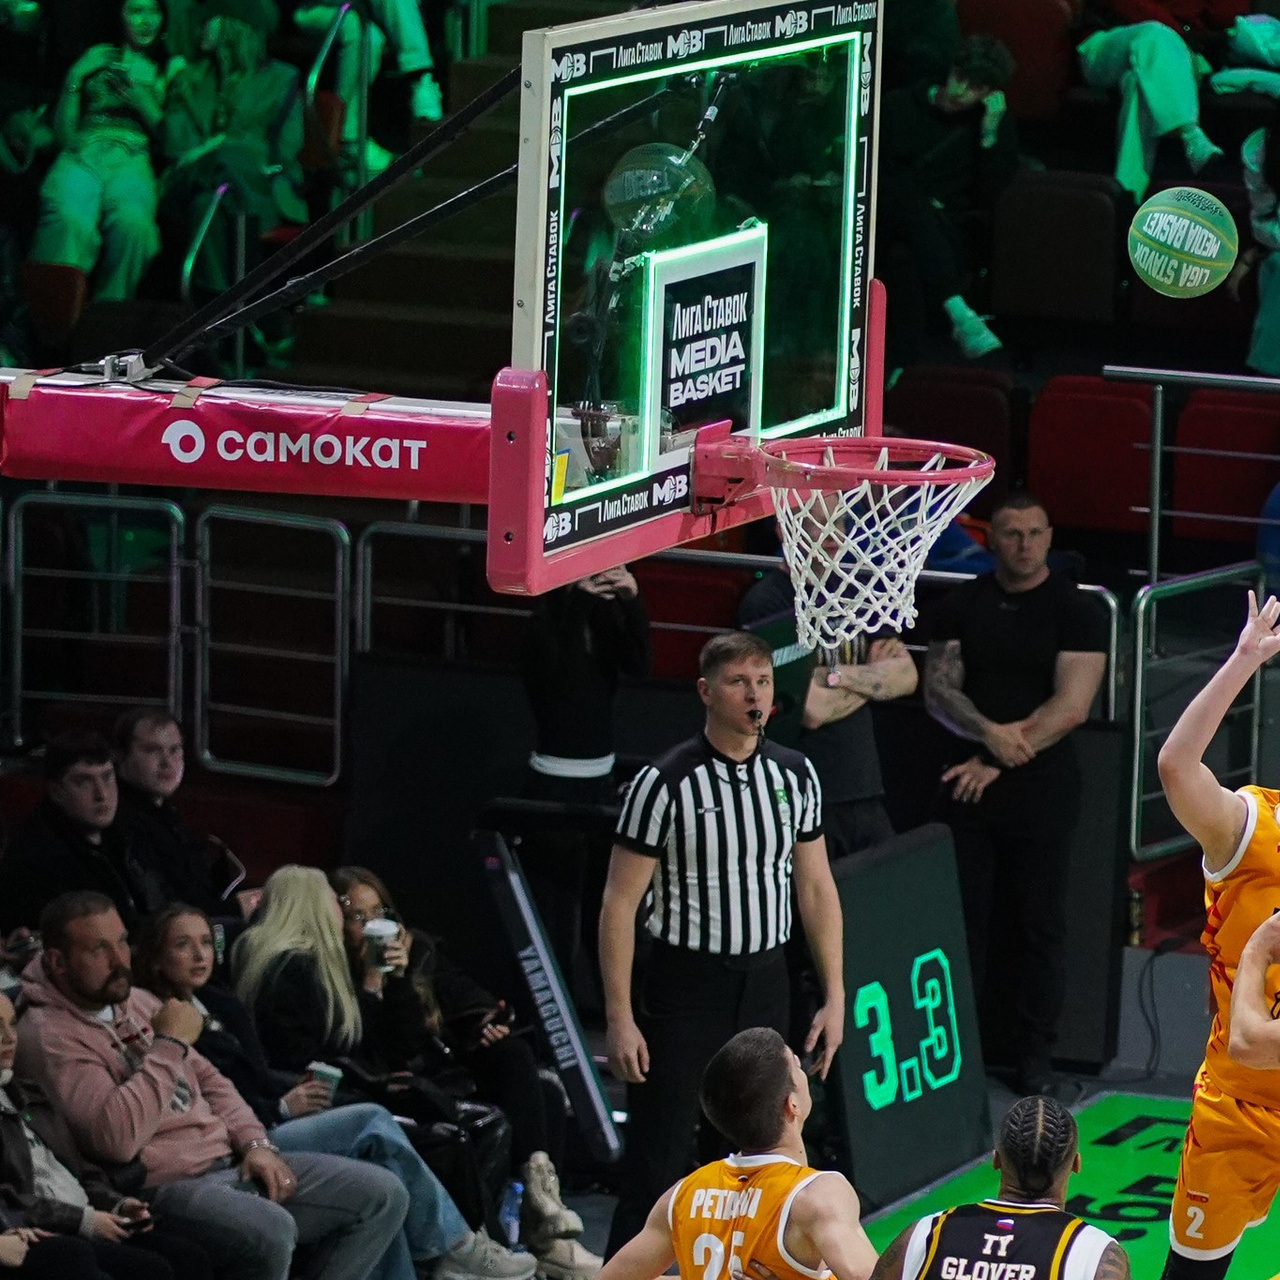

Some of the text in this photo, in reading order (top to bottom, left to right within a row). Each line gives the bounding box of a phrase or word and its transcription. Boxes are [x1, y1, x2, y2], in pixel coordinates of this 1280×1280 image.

[1142, 212, 1221, 259] MEDIA BASKET
[670, 330, 746, 380] MEDIA
[669, 363, 746, 408] BASKET
[216, 427, 428, 471] самокат
[518, 944, 580, 1070] YAMAGUCHI
[1186, 1205, 1205, 1239] 2
[982, 1233, 1015, 1257] TY
